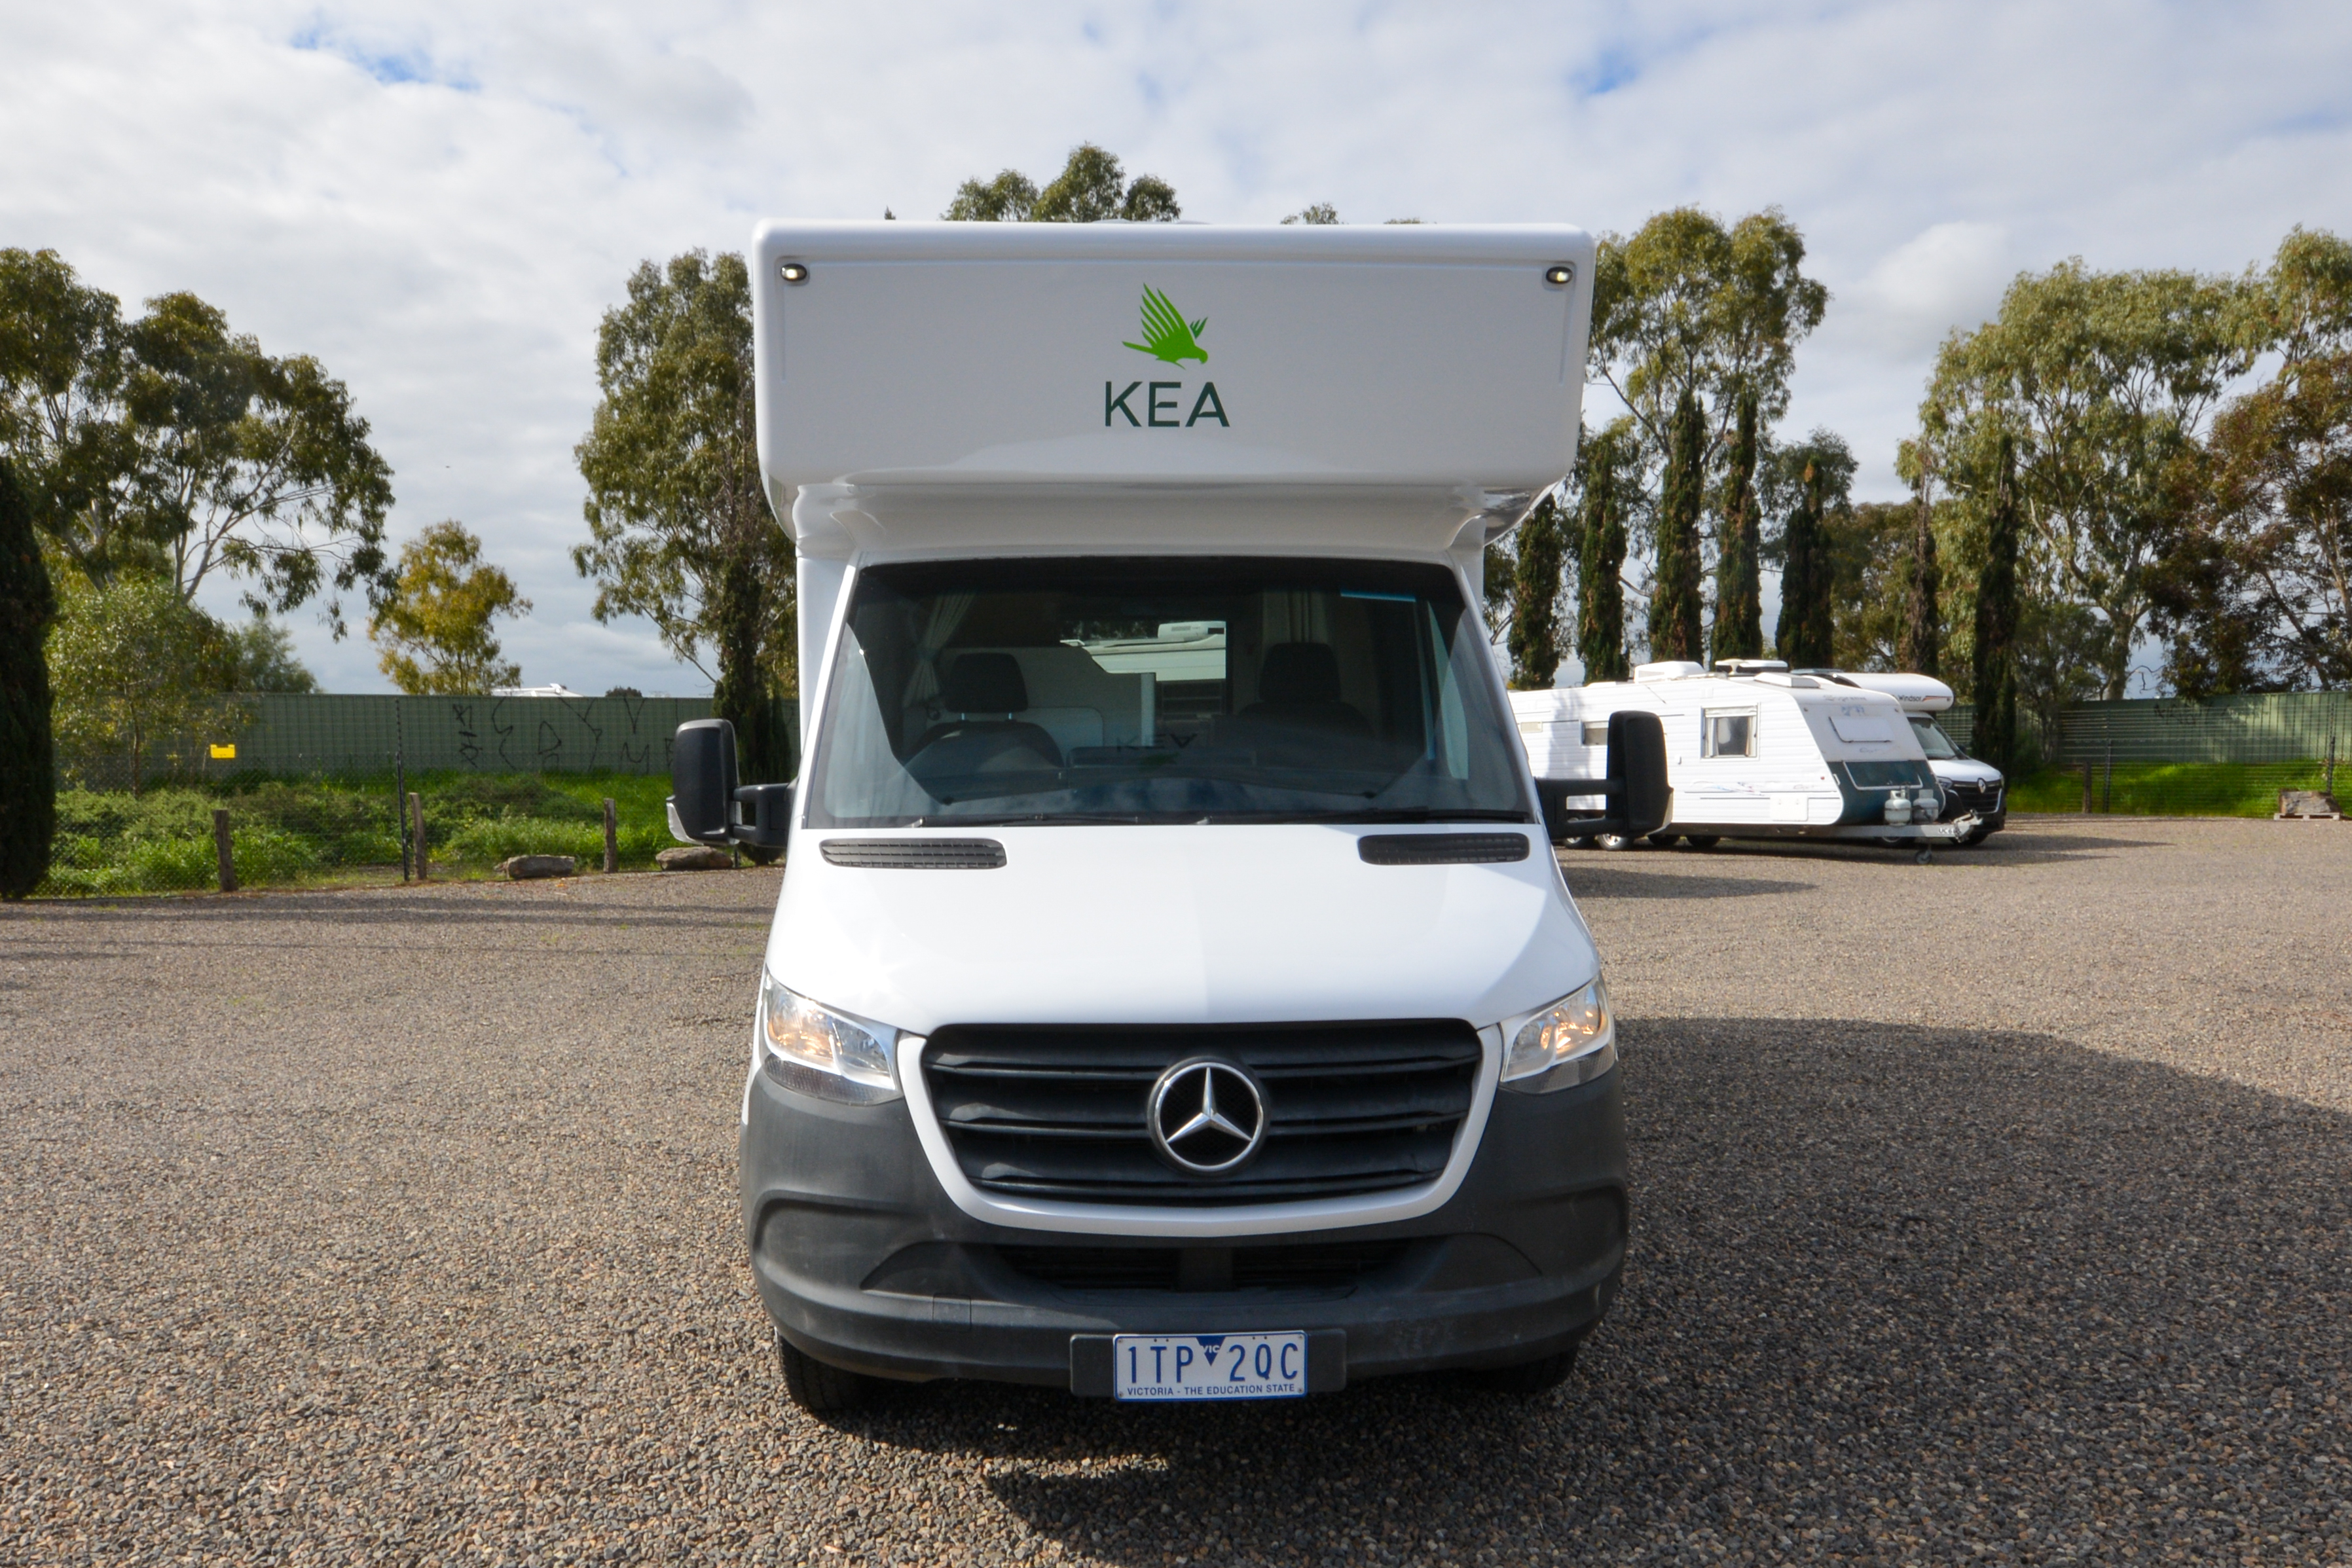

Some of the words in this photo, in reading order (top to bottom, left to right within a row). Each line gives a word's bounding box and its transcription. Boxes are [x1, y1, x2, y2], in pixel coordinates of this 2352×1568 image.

[1105, 381, 1230, 427] KEA
[1201, 1345, 1220, 1353] VIC
[1128, 1345, 1194, 1383] 1TP
[1228, 1343, 1298, 1381] 2QC
[1185, 1387, 1203, 1395] THE
[1207, 1385, 1262, 1395] EDUCATION
[1266, 1383, 1295, 1393] STATE
